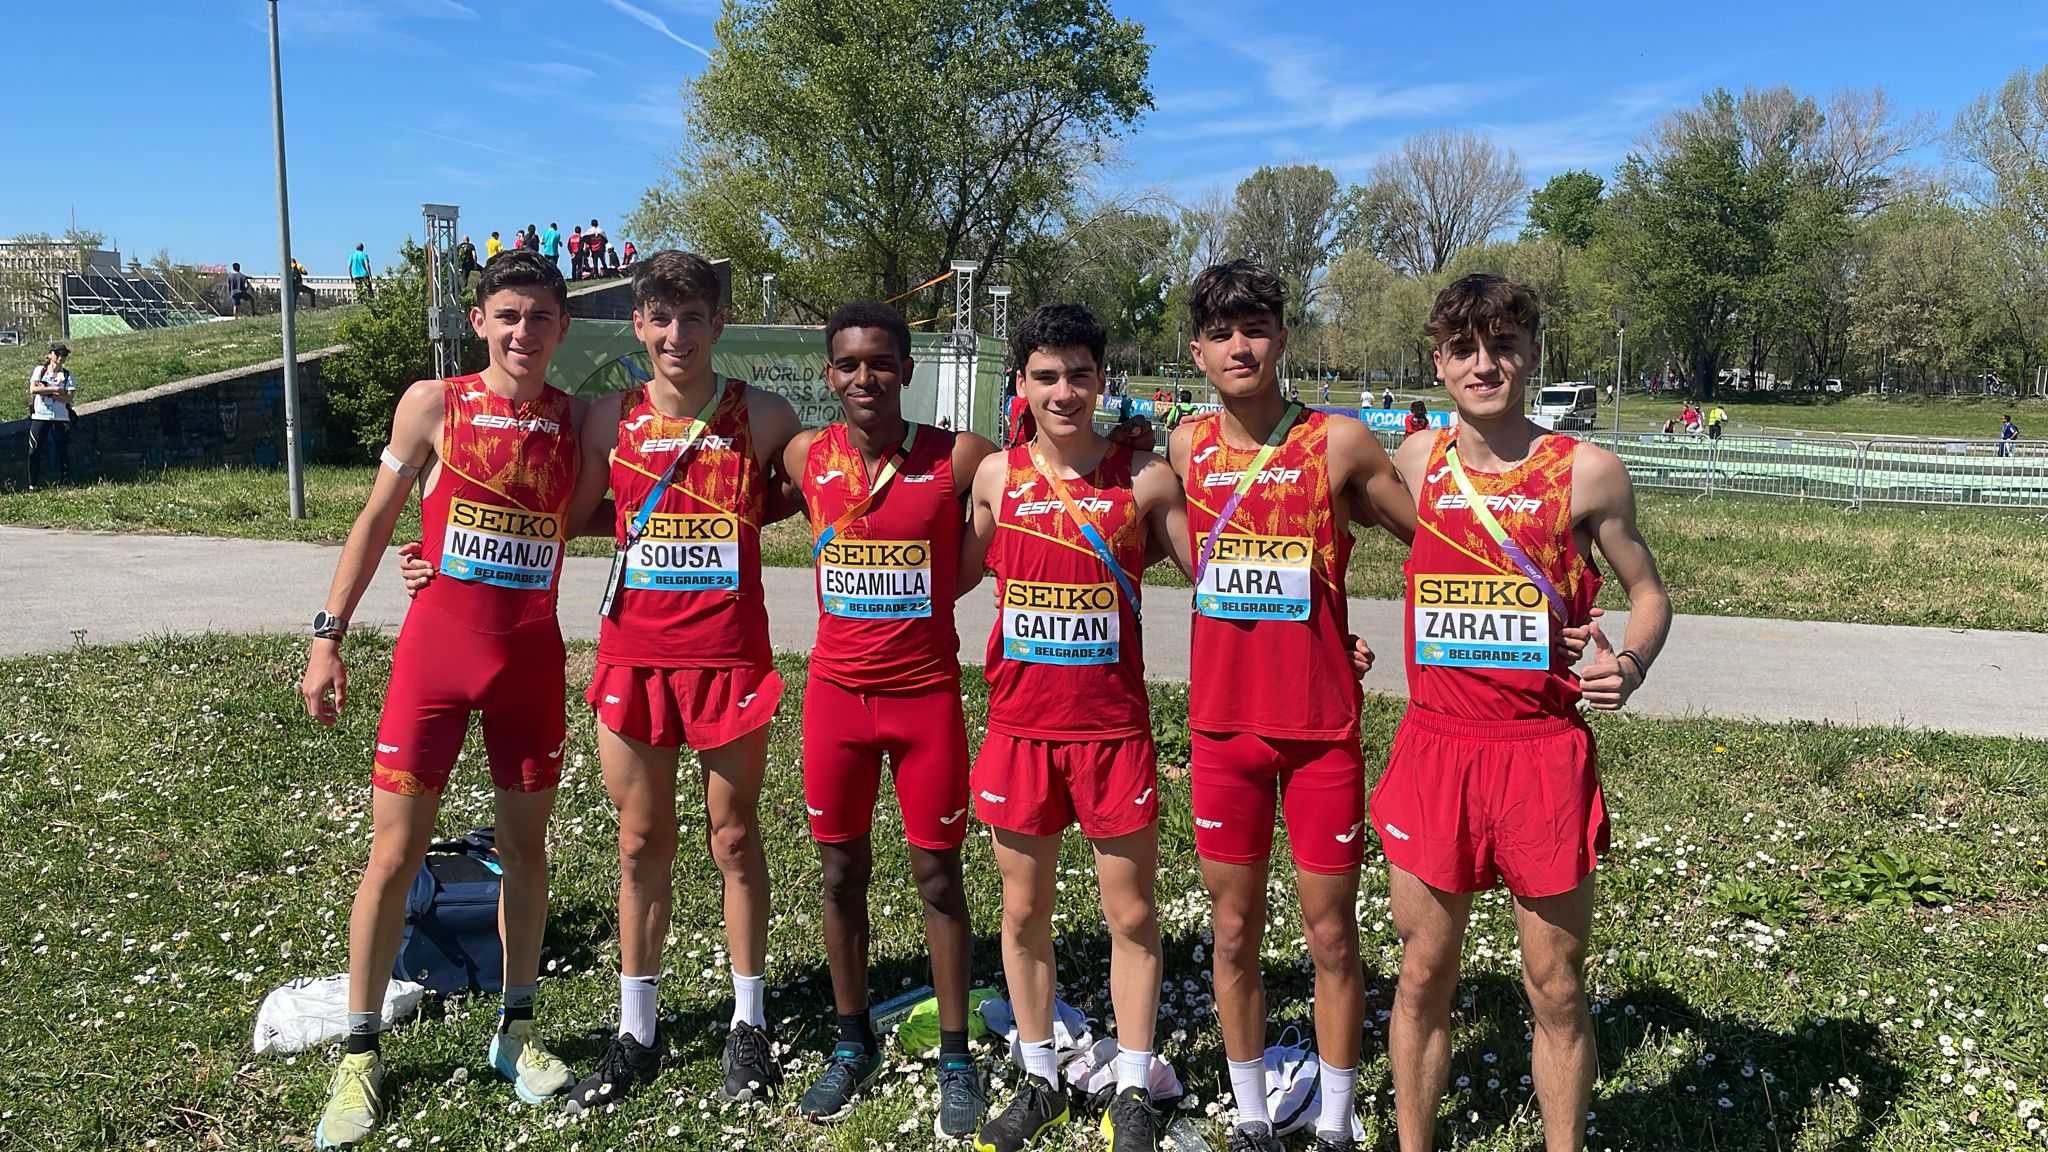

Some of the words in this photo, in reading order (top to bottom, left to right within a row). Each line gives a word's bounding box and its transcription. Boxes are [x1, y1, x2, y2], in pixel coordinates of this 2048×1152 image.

[752, 366, 814, 382] WORLD
[798, 405, 846, 421] MPION
[1366, 411, 1442, 427] VODADA
[903, 473, 934, 483] ESP
[1435, 494, 1543, 514] ESAÑA
[453, 503, 557, 538] SEIKO
[451, 531, 553, 568] NARANJO
[640, 544, 723, 568] SOUSA
[823, 542, 926, 566] SEIKO
[473, 567, 534, 584] BELGRADE
[534, 573, 548, 584] 24
[655, 575, 715, 585] BELGRADE
[717, 576, 733, 584] 24
[826, 569, 926, 596] ESCAMILLA
[1215, 567, 1283, 595] LARA
[1008, 583, 1115, 610] SEIKO
[1420, 580, 1543, 608] SEIKO
[849, 602, 907, 613] BELGRADE
[1221, 601, 1284, 613] BELGRADE
[1286, 603, 1305, 614] 24
[1015, 614, 1108, 642] GAITAN
[1425, 612, 1538, 642] ZARATE
[1034, 646, 1095, 658] BELGRADE
[1097, 647, 1113, 657] 24
[1449, 648, 1519, 662] BELGRADE
[1521, 651, 1542, 662] 24
[377, 742, 399, 754] ESP
[979, 789, 1007, 803] ESP
[1195, 816, 1223, 830] ESP
[1385, 823, 1410, 841] ESP
